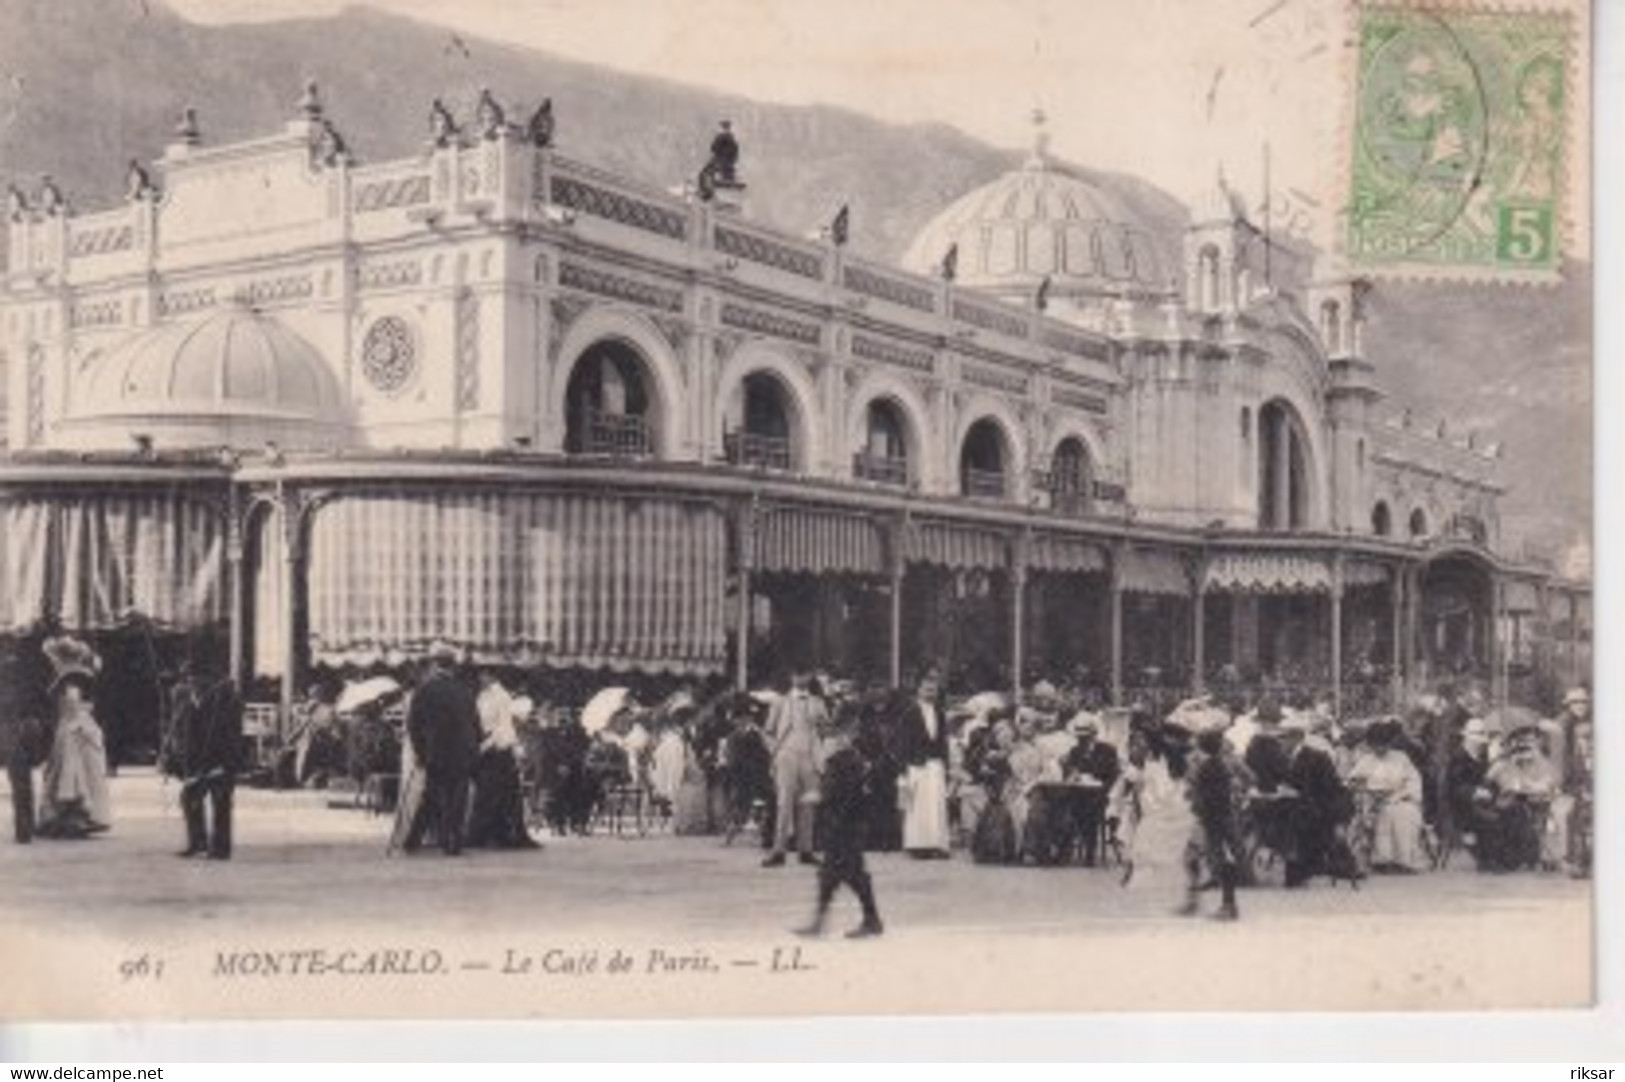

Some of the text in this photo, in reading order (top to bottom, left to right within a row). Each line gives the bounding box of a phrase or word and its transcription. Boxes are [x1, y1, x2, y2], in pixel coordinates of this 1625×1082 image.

[1508, 209, 1545, 260] 5
[501, 949, 533, 974] Le
[606, 949, 634, 973] de
